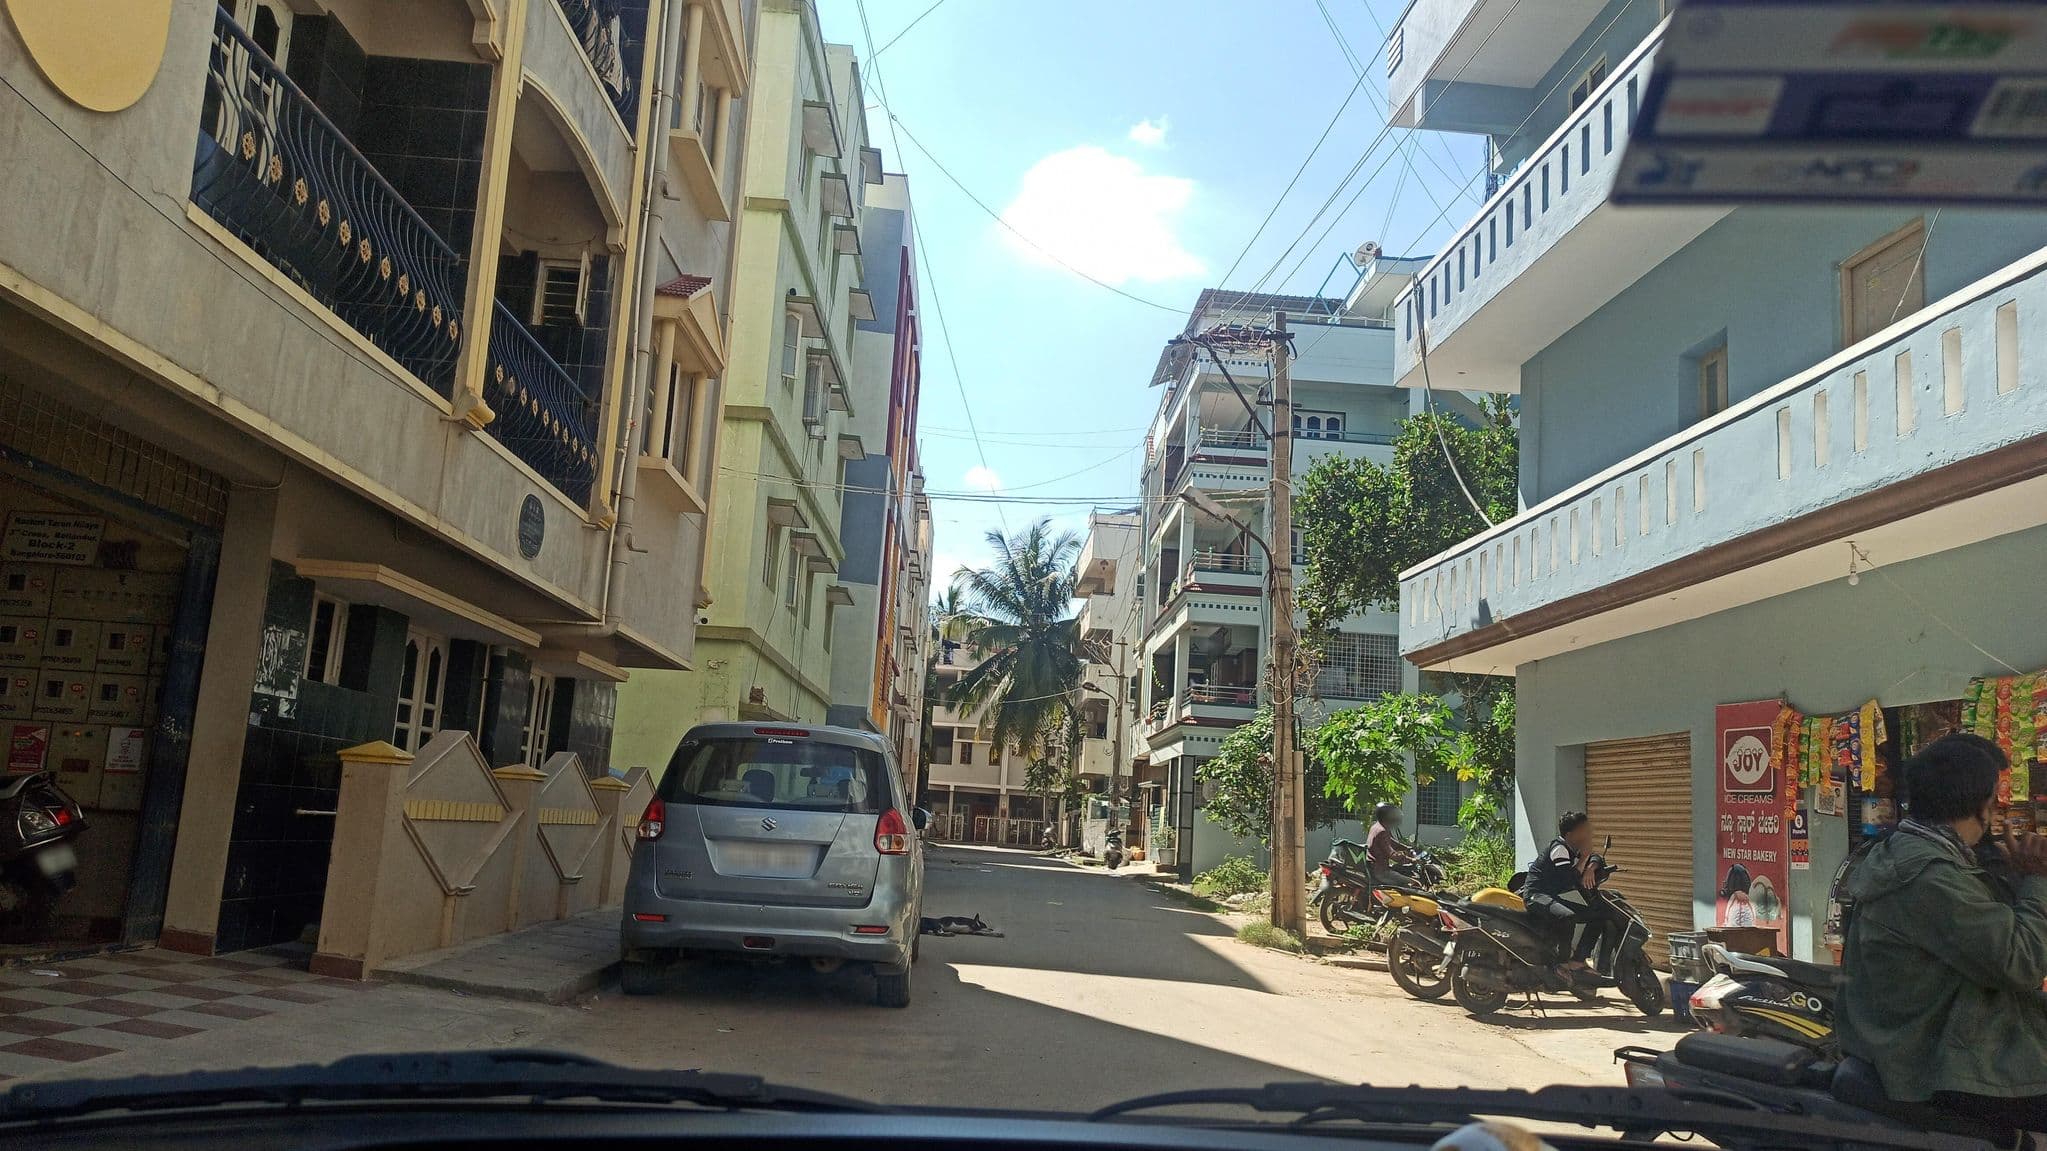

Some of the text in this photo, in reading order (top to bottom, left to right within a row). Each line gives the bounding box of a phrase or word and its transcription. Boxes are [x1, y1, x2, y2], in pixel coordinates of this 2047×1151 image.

[28, 539, 75, 550] Block-2
[1733, 749, 1763, 772] JOY
[1724, 795, 1773, 805] ICE CREAMS
[1723, 848, 1777, 863] NEW STAR BAKERY
